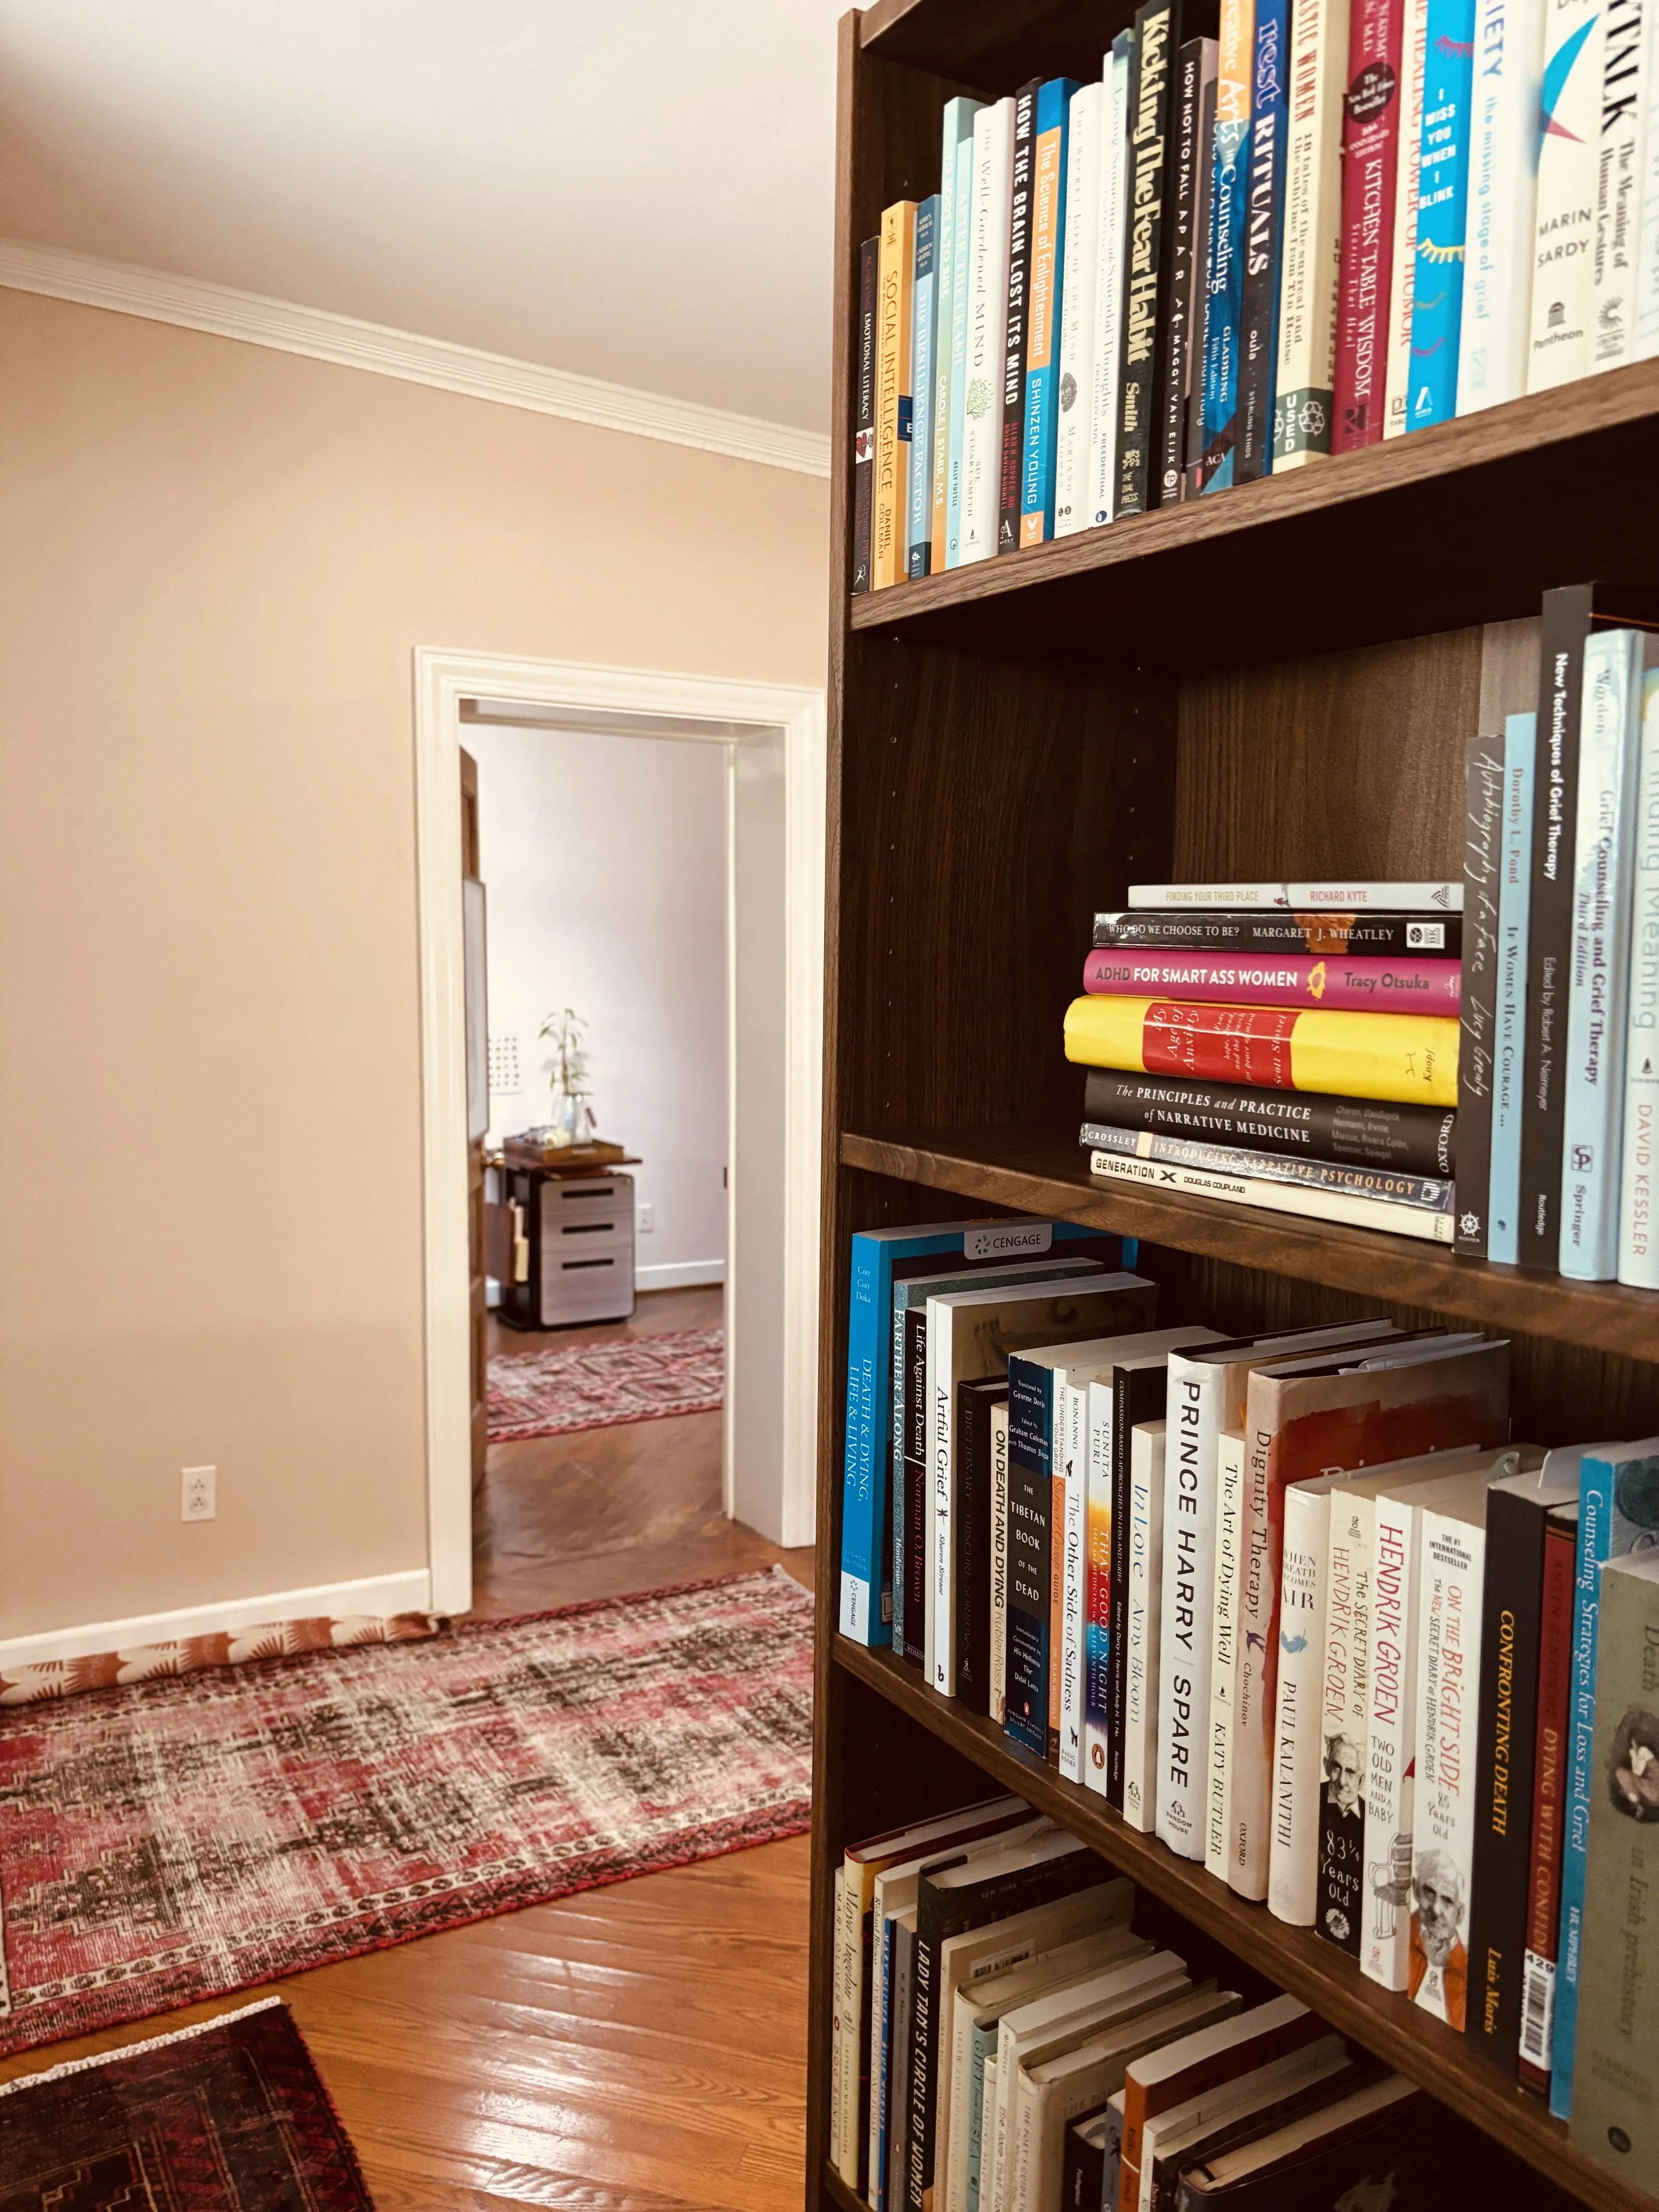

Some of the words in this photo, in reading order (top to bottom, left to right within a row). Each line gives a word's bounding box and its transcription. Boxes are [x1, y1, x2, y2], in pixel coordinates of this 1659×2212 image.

[1133, 7, 1171, 145] Kicking
[1439, 88, 1444, 101] I
[1016, 94, 1031, 140] HOW
[1220, 78, 1246, 144] Arts
[1425, 104, 1455, 126] MISS
[1041, 141, 1056, 171] The
[1421, 144, 1456, 168] WHEN
[1427, 126, 1451, 145] YOU
[1015, 145, 1029, 186] THE
[1135, 135, 1165, 205] The
[1435, 171, 1439, 183] I
[1037, 176, 1054, 232] Science
[1249, 113, 1275, 276] RITUALS
[1362, 159, 1382, 247] KITCHEN
[1419, 186, 1454, 210] BLINK
[1012, 191, 1027, 254] BRAIN
[1035, 236, 1049, 250] of
[1131, 199, 1161, 275] Fear
[1212, 164, 1236, 293] Counseling
[1538, 207, 1592, 238] MARIN
[1537, 240, 1590, 267] SARDY
[1009, 259, 1023, 305] LOST
[1358, 250, 1377, 308] TABLE
[885, 271, 898, 346] SOCIAL
[1030, 253, 1052, 358] Enlightenment
[1127, 271, 1158, 365] Habit
[863, 312, 873, 374] EMOTIONAL
[1008, 315, 1021, 348] ITS
[1248, 331, 1260, 360] oula
[1171, 335, 1182, 386] MAGGY
[1220, 326, 1231, 402] GLADDING
[1354, 308, 1375, 400] WISDOM
[861, 374, 870, 420] LITERACY
[937, 375, 947, 423] CAROLE
[1005, 354, 1019, 405] MIND
[881, 350, 896, 492] INTELLIGENCE
[1029, 378, 1041, 446] SHINZEN
[1124, 382, 1139, 433] Smith
[1169, 394, 1178, 423] VAN
[1286, 395, 1296, 451] USED
[936, 427, 945, 436] J.
[1167, 433, 1178, 464] EIJK
[936, 439, 945, 480] STARR,
[1027, 449, 1039, 504] YOUNG
[934, 482, 943, 509] M.S.
[877, 503, 886, 559] GOLEMAN
[1554, 652, 1569, 688] New
[1548, 690, 1567, 767] Techniques
[1550, 769, 1565, 784] of
[1548, 786, 1563, 822] Grief
[1544, 824, 1563, 881] Therapy
[1165, 891, 1192, 903] FINDING
[1194, 891, 1214, 903] YOUR
[1214, 890, 1234, 902] THIRD
[1236, 889, 1260, 902] PLACE
[1309, 890, 1345, 903] RICHARD
[1346, 889, 1368, 903] KYTE
[1109, 922, 1133, 934] WHO
[1133, 922, 1147, 934] DO
[1147, 924, 1161, 935] WE
[1163, 924, 1203, 936] CHOOSE
[1205, 926, 1220, 937] TO
[1222, 926, 1240, 937] BE?
[1252, 926, 1312, 938] MARGARET
[1315, 927, 1327, 942] J.
[1329, 928, 1394, 941] WHEATLEY
[1095, 966, 1131, 981] ADHD
[1133, 967, 1160, 980] FOR
[1161, 969, 1208, 983] SMART
[1208, 970, 1235, 984] ASS
[1238, 971, 1298, 987] WOMEN
[1344, 972, 1378, 994] Tracy
[1381, 973, 1430, 990] Otsuka
[1542, 956, 1557, 990] Edited
[1539, 992, 1555, 1007] by
[1542, 1008, 1554, 1041] Robert
[1423, 1047, 1438, 1083] Knopf
[1540, 1043, 1553, 1056] A.
[1116, 1084, 1134, 1098] The
[1137, 1086, 1210, 1107] PRINCIPLES
[1214, 1098, 1236, 1112] and
[1238, 1102, 1312, 1121] PRACTICE
[1536, 1059, 1551, 1112] Neimeyer
[1088, 1130, 1137, 1147] CROSSLEY
[1143, 1109, 1155, 1123] of
[1157, 1110, 1232, 1132] NARRATIVE
[1236, 1120, 1311, 1143] MEDICINE
[1437, 1114, 1455, 1173] OXFORD
[1096, 1157, 1155, 1180] GENERATION
[1158, 1169, 1178, 1183] X
[1183, 1175, 1212, 1189] DOUGLAS
[1212, 1181, 1246, 1194] COUPLAND
[993, 1234, 1042, 1250] CENGAGE
[893, 1308, 904, 1392] FARTHER
[915, 1323, 925, 1352] Life
[849, 1366, 860, 1402] LIFE
[860, 1357, 872, 1420] DEATH
[914, 1354, 924, 1409] Against
[848, 1406, 858, 1422] &
[859, 1424, 870, 1439] &
[893, 1397, 904, 1461] ALONG
[915, 1412, 924, 1456] Death
[846, 1424, 857, 1487] LIVING
[995, 1430, 1006, 1456] ON
[1178, 1380, 1201, 1515] PRINCE
[857, 1442, 869, 1503] DYING,
[995, 1459, 1006, 1514] DEATH
[1024, 1484, 1034, 1496] THE
[1224, 1463, 1239, 1499] The
[1010, 1501, 1046, 1528] TIBETAN
[1068, 1493, 1080, 1526] The
[1222, 1503, 1237, 1535] Art
[994, 1515, 1005, 1554] AND
[1015, 1529, 1040, 1551] BOOK
[1066, 1531, 1080, 1581] Other
[1220, 1539, 1235, 1562] of
[1576, 1489, 1604, 1591] Counseling
[994, 1556, 1005, 1609] DYING
[1018, 1560, 1027, 1570] OF
[1027, 1564, 1037, 1576] THE
[1175, 1528, 1196, 1651] HARRY
[1376, 1522, 1405, 1637] HENDRIK
[1015, 1579, 1039, 1602] DEAD
[1065, 1585, 1078, 1623] Side
[1217, 1562, 1235, 1619] Dying
[1064, 1626, 1077, 1647] of
[1217, 1624, 1232, 1666] Well
[1573, 1599, 1600, 1686] Strategies
[1064, 1647, 1076, 1712] Sadness
[1373, 1640, 1402, 1726] GROEN
[1494, 1609, 1515, 1764] CONFRONTING
[1281, 1680, 1297, 1730] PAUL
[1577, 1690, 1596, 1718] for
[1169, 1674, 1192, 1789] SPARE
[1576, 1721, 1593, 1762] Loss
[1277, 1736, 1295, 1848] KALANITHI
[1491, 1763, 1509, 1838] DEATH
[1573, 1765, 1591, 1804] and
[916, 1940, 931, 1990] LADY
[914, 1992, 929, 2046] TAN'S
[912, 2047, 927, 2114] CIRCLE
[911, 2113, 924, 2138] OF
[910, 2140, 923, 2209] WOMEN
